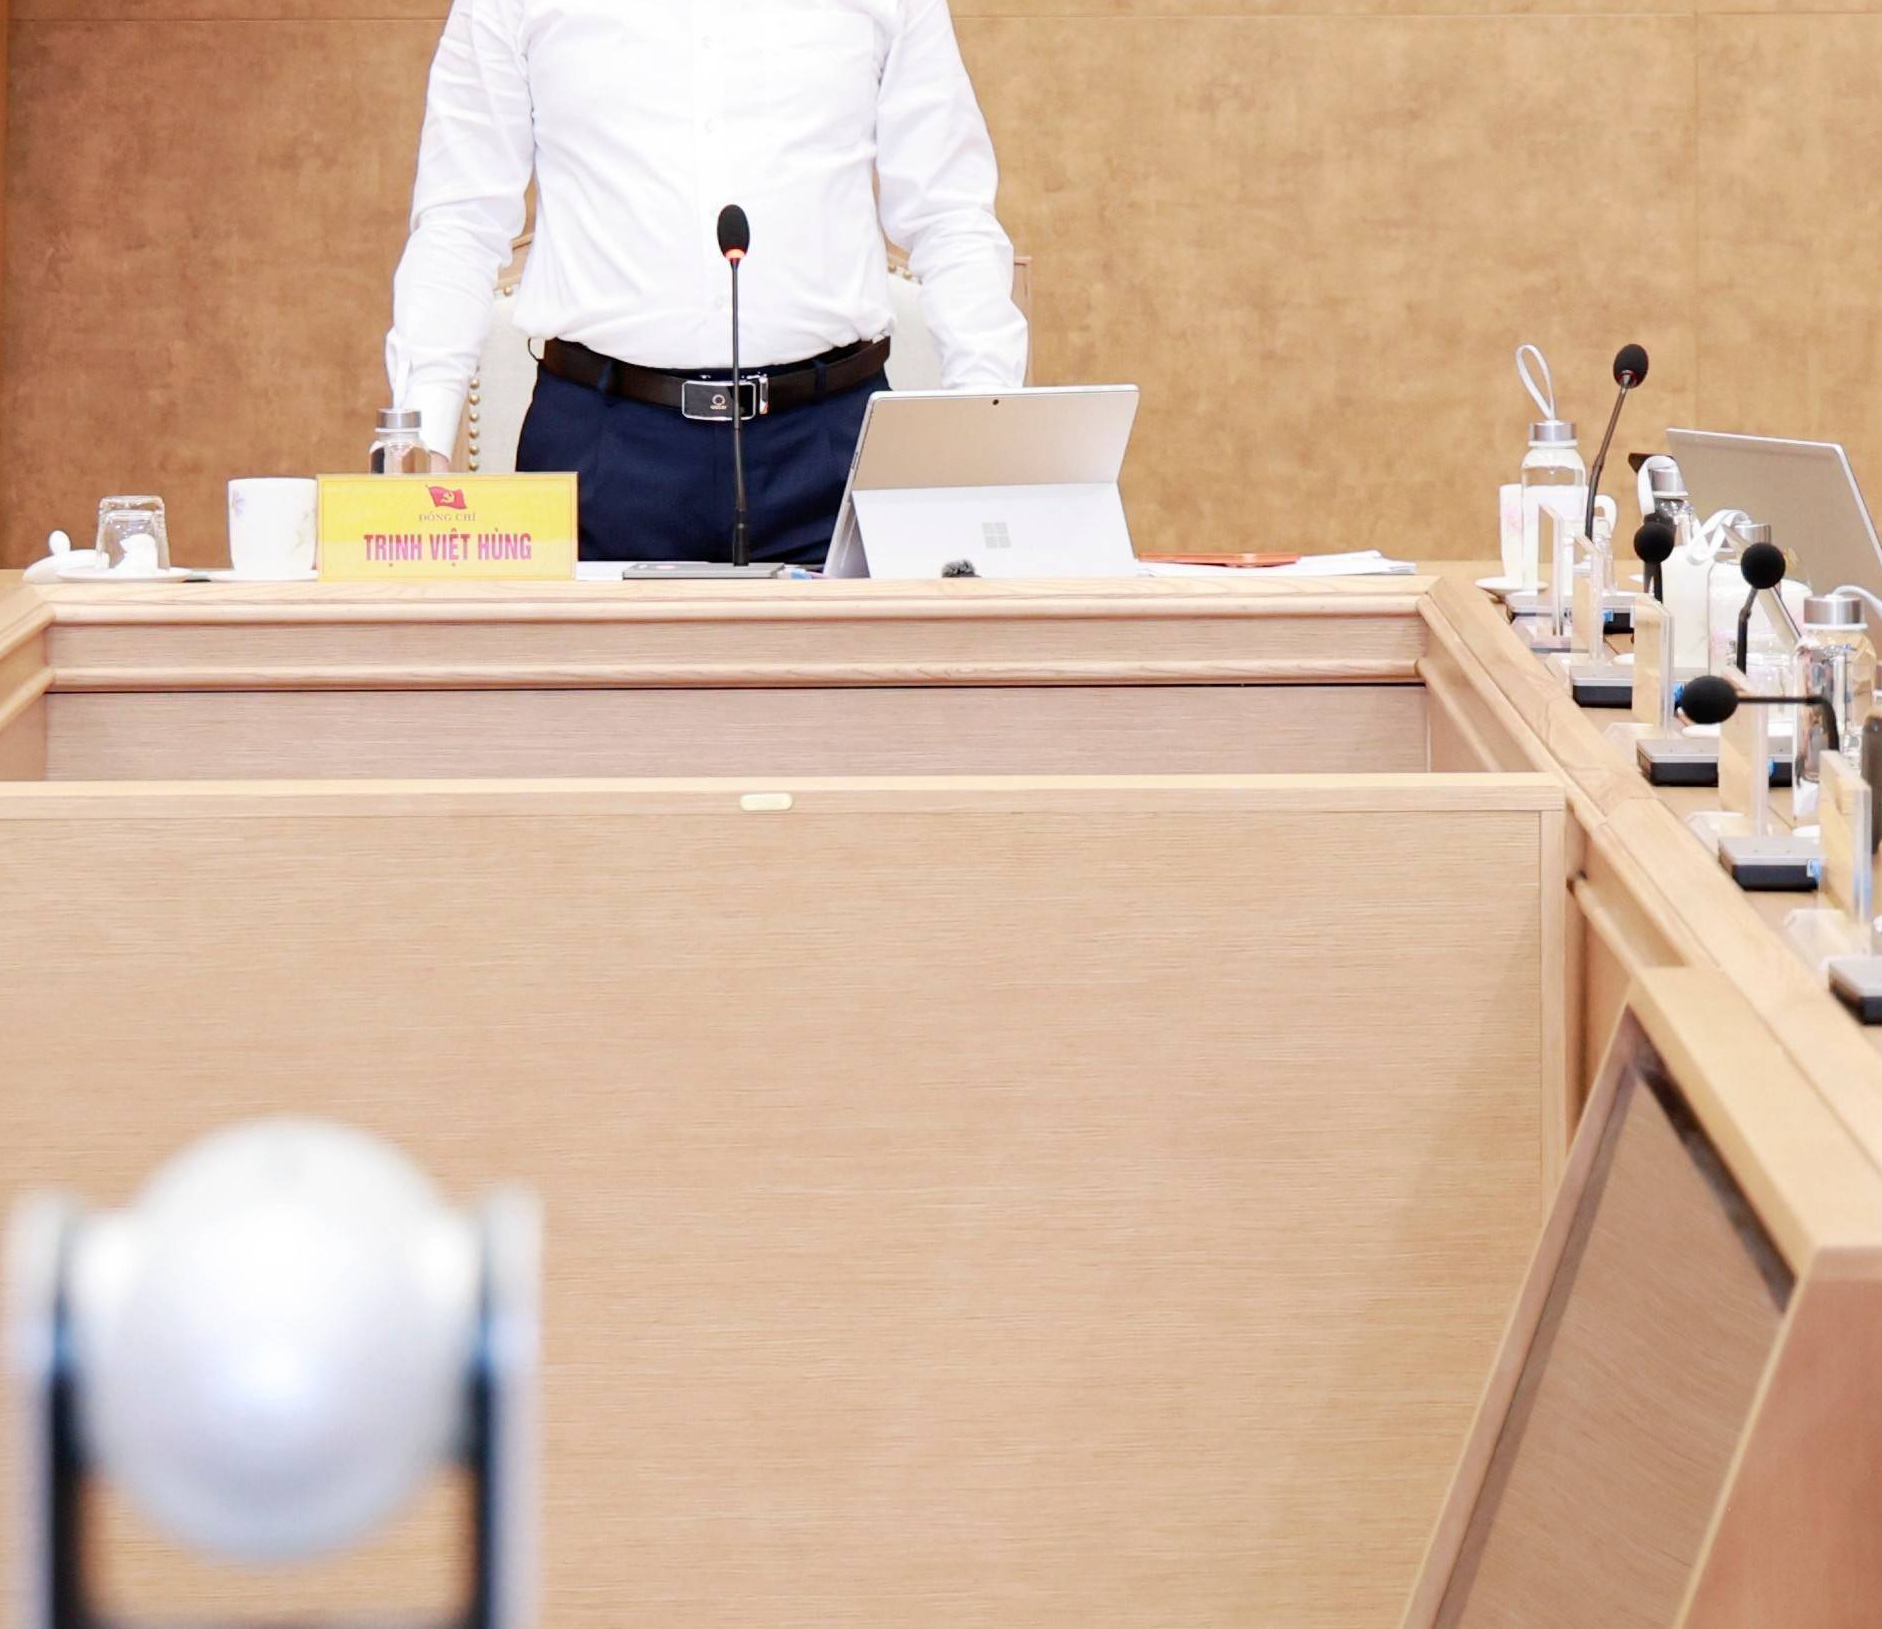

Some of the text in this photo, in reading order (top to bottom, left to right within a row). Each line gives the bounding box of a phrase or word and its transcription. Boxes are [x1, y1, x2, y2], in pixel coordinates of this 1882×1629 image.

[363, 527, 532, 567] TRỊNH VIỆT HÙNG
